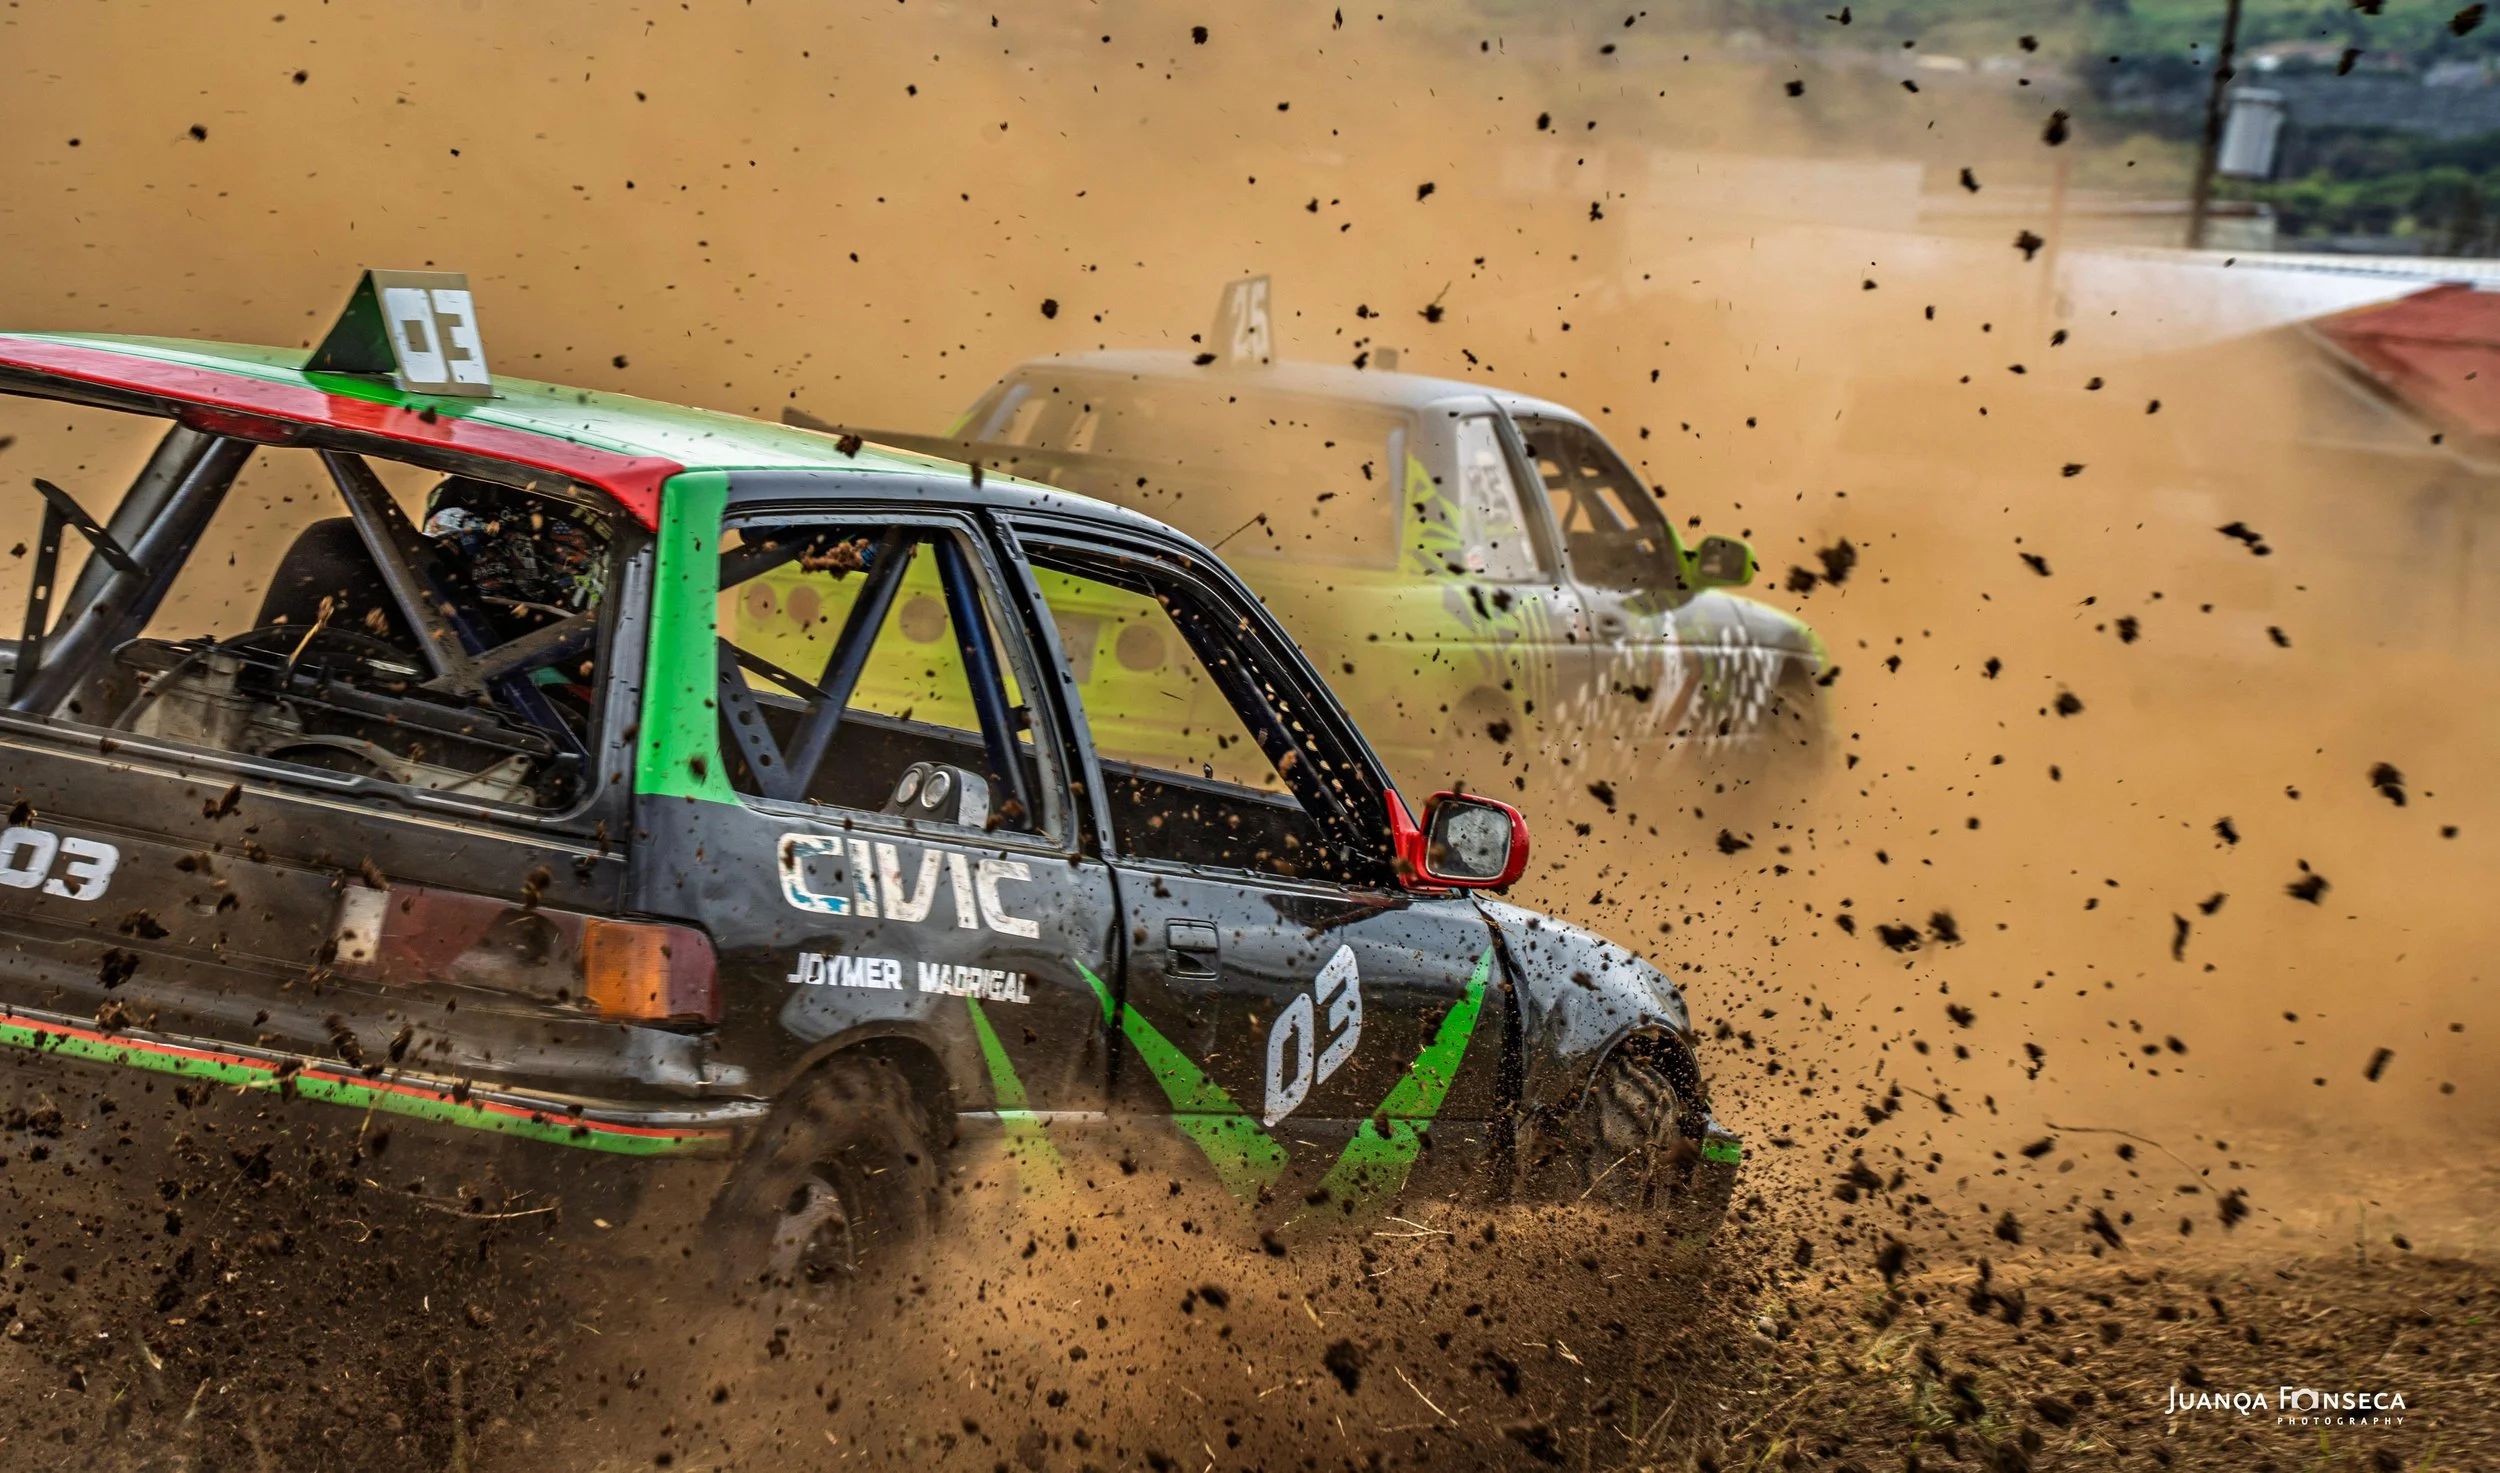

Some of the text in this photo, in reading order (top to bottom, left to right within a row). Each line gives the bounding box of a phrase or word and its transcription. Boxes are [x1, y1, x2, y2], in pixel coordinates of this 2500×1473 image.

[382, 287, 492, 385] 03
[1230, 280, 1270, 362] 25
[0, 826, 120, 901] 03
[776, 832, 1040, 939] CIVIC
[786, 952, 1031, 1004] JOYMER MADRIGAL
[1263, 944, 1363, 1128] 03
